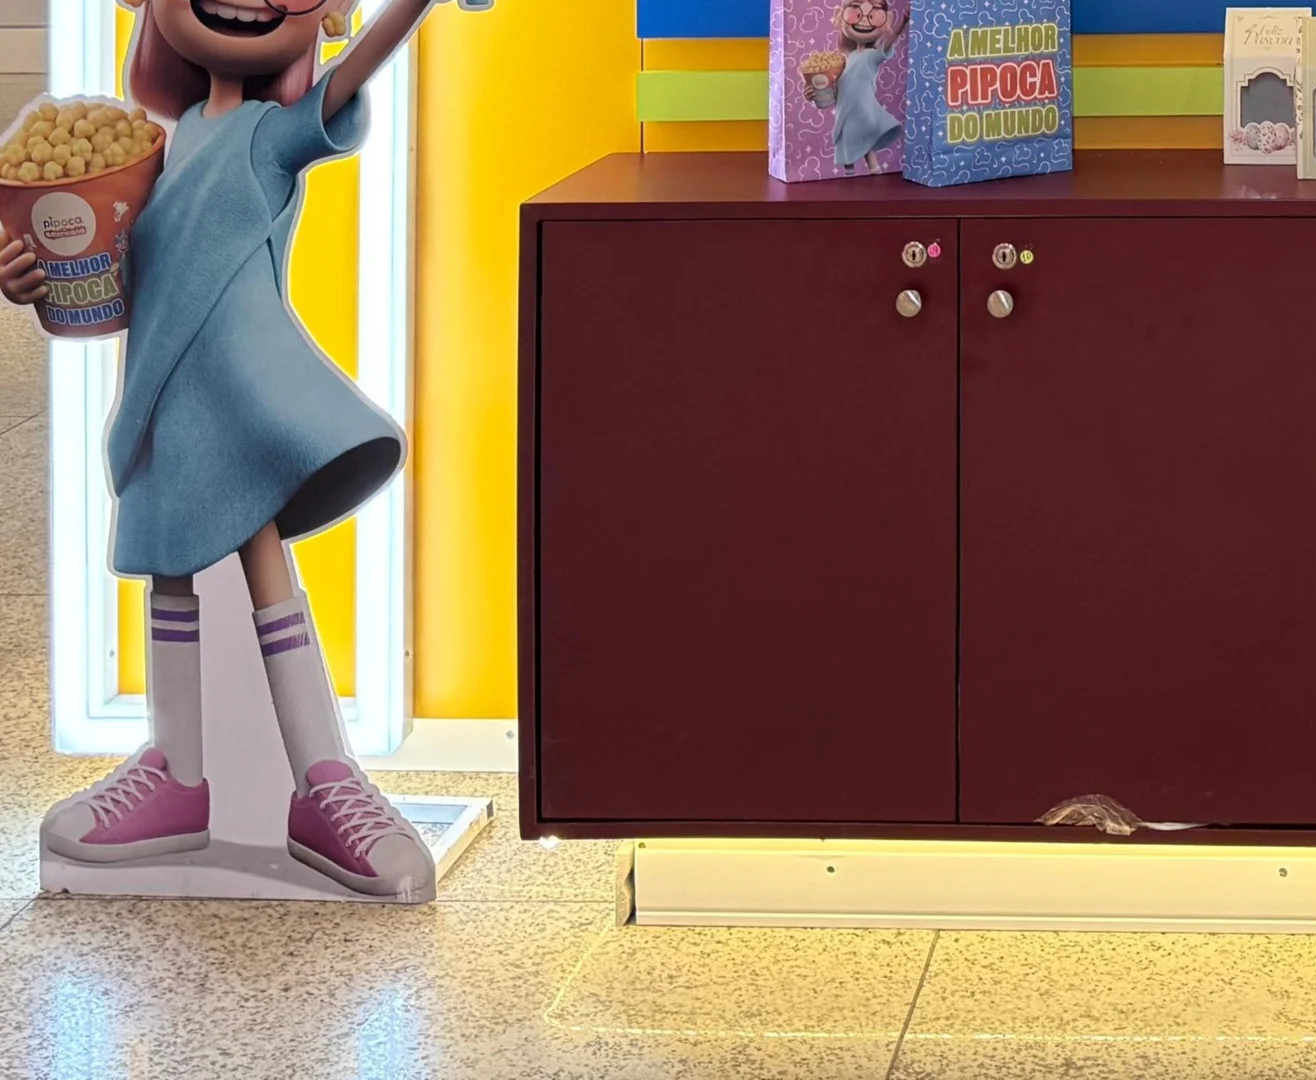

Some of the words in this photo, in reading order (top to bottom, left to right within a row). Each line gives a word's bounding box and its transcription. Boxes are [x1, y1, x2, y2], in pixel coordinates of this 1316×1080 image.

[947, 29, 966, 60] A
[968, 23, 1059, 56] MELHOR
[947, 60, 1058, 107] PIPOCA
[947, 111, 981, 143] DO
[984, 105, 1059, 139] MUNDO
[43, 216, 83, 230] pipoca
[48, 252, 112, 278] MELHOR
[46, 305, 66, 324] DO
[67, 298, 125, 325] MUNDO
